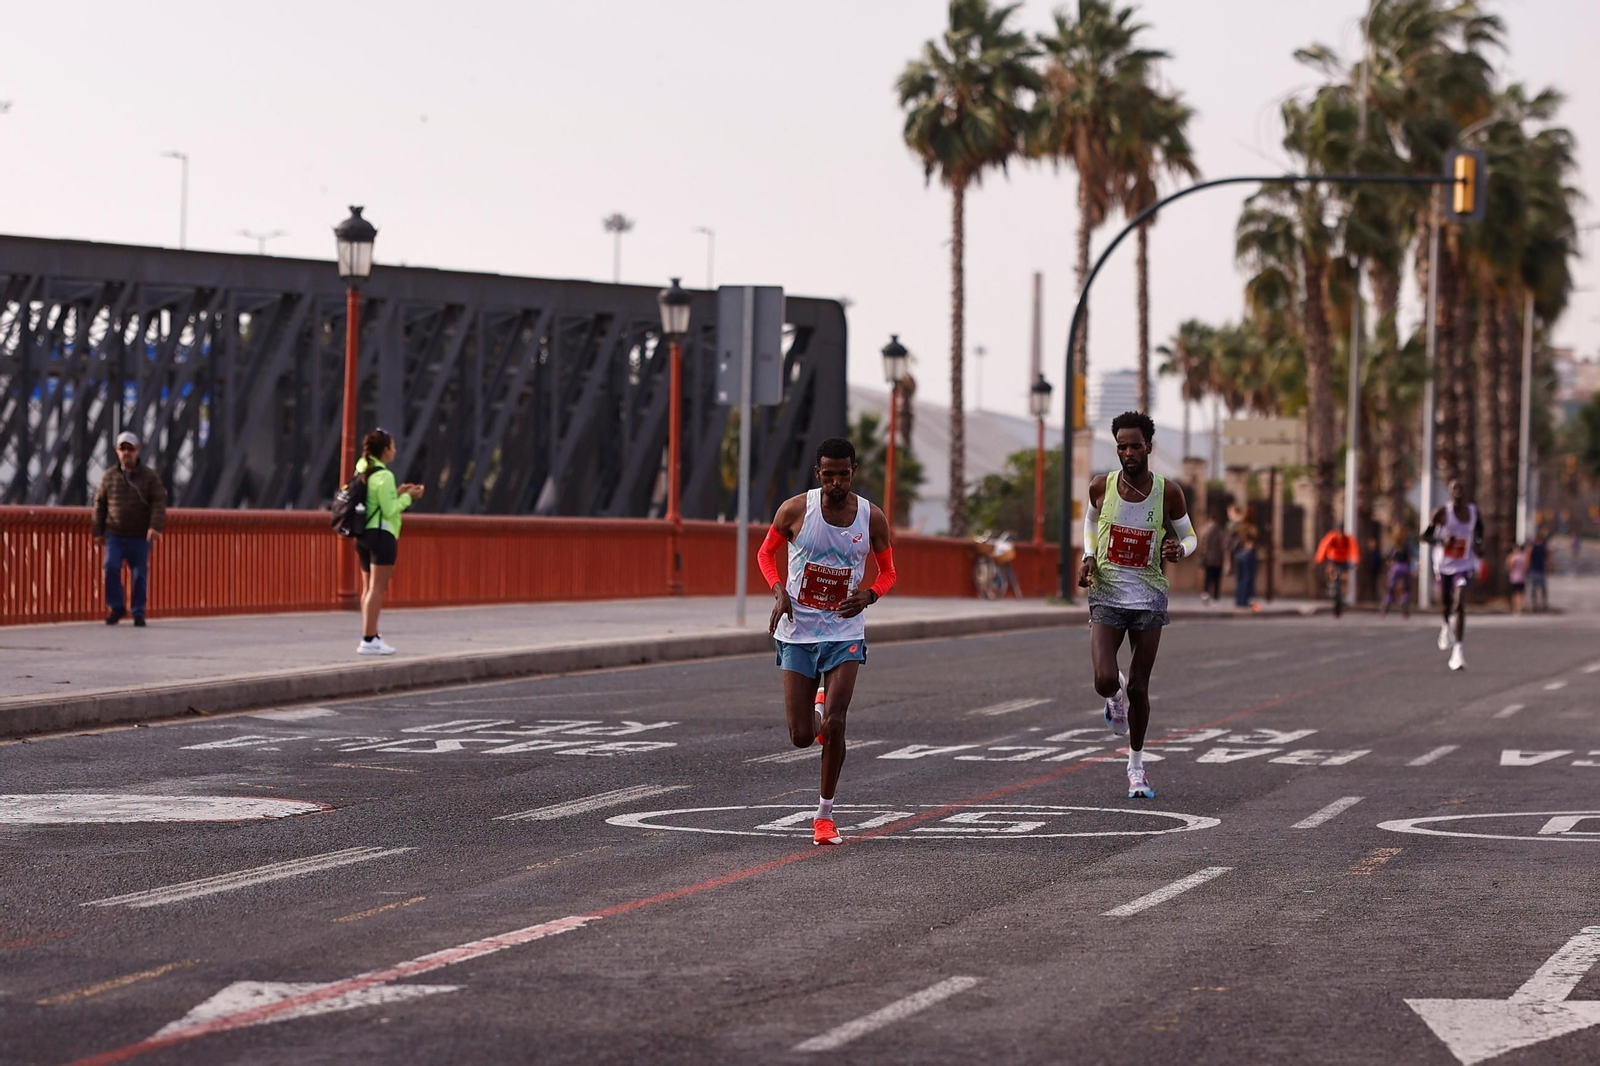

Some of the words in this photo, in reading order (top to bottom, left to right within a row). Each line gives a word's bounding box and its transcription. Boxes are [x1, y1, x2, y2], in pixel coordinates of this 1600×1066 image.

[1122, 528, 1150, 536] GENERALI
[818, 566, 848, 576] GENERALI
[816, 576, 838, 585] ENYEW
